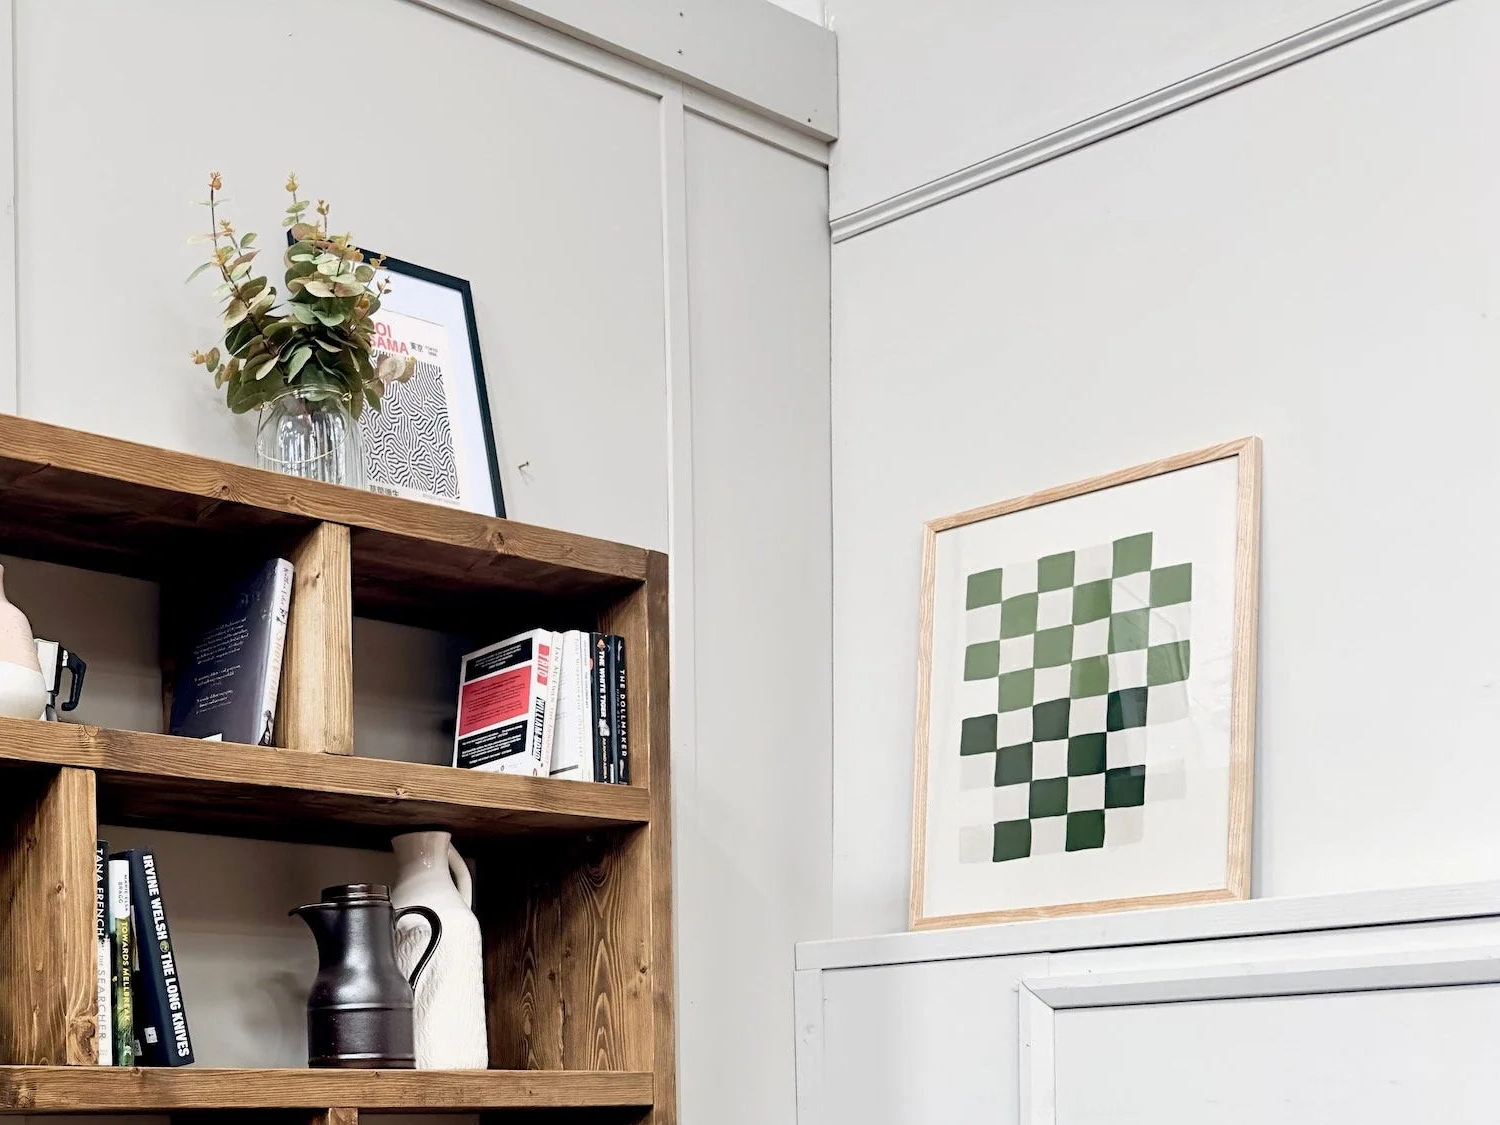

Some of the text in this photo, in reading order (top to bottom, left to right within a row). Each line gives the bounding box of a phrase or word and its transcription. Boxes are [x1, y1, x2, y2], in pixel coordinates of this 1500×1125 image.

[598, 650, 606, 667] THE
[599, 667, 607, 694] WHITE
[534, 696, 546, 736] WILLIAM
[620, 693, 628, 757] DOLLMAKER
[96, 848, 105, 939] TANA FRENCH
[121, 921, 131, 1022] TOWARDS MELLBREAK
[142, 854, 190, 1058] IRVINE WELSH THE LONG KNIVES
[98, 969, 107, 1040] SEARCHER
